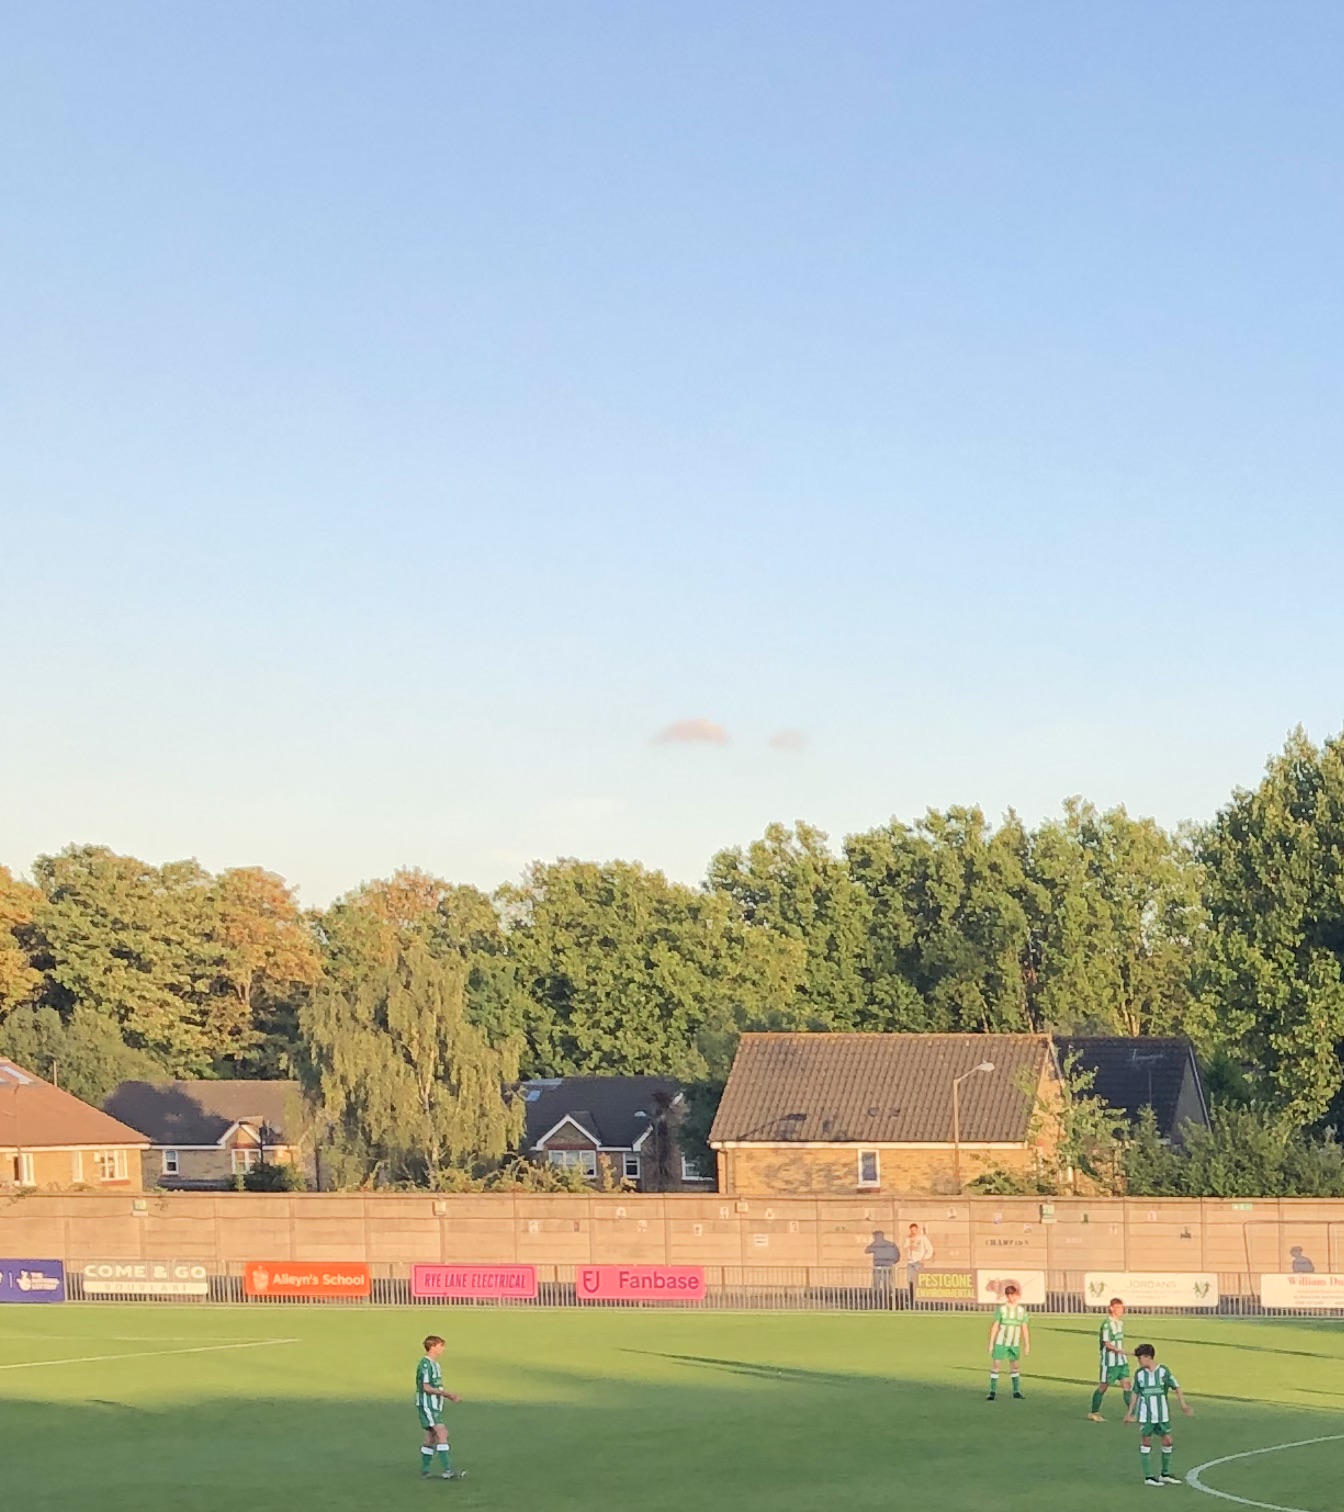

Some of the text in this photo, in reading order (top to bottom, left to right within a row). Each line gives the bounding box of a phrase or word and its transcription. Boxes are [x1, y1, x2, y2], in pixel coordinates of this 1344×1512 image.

[83, 1264, 206, 1280] COME & GO
[272, 1272, 365, 1287] Alleyn's School
[619, 1271, 699, 1289] Fanbase
[918, 1273, 973, 1287] PESTGONE
[424, 1273, 526, 1289] RYE LANE ELECTRICAL
